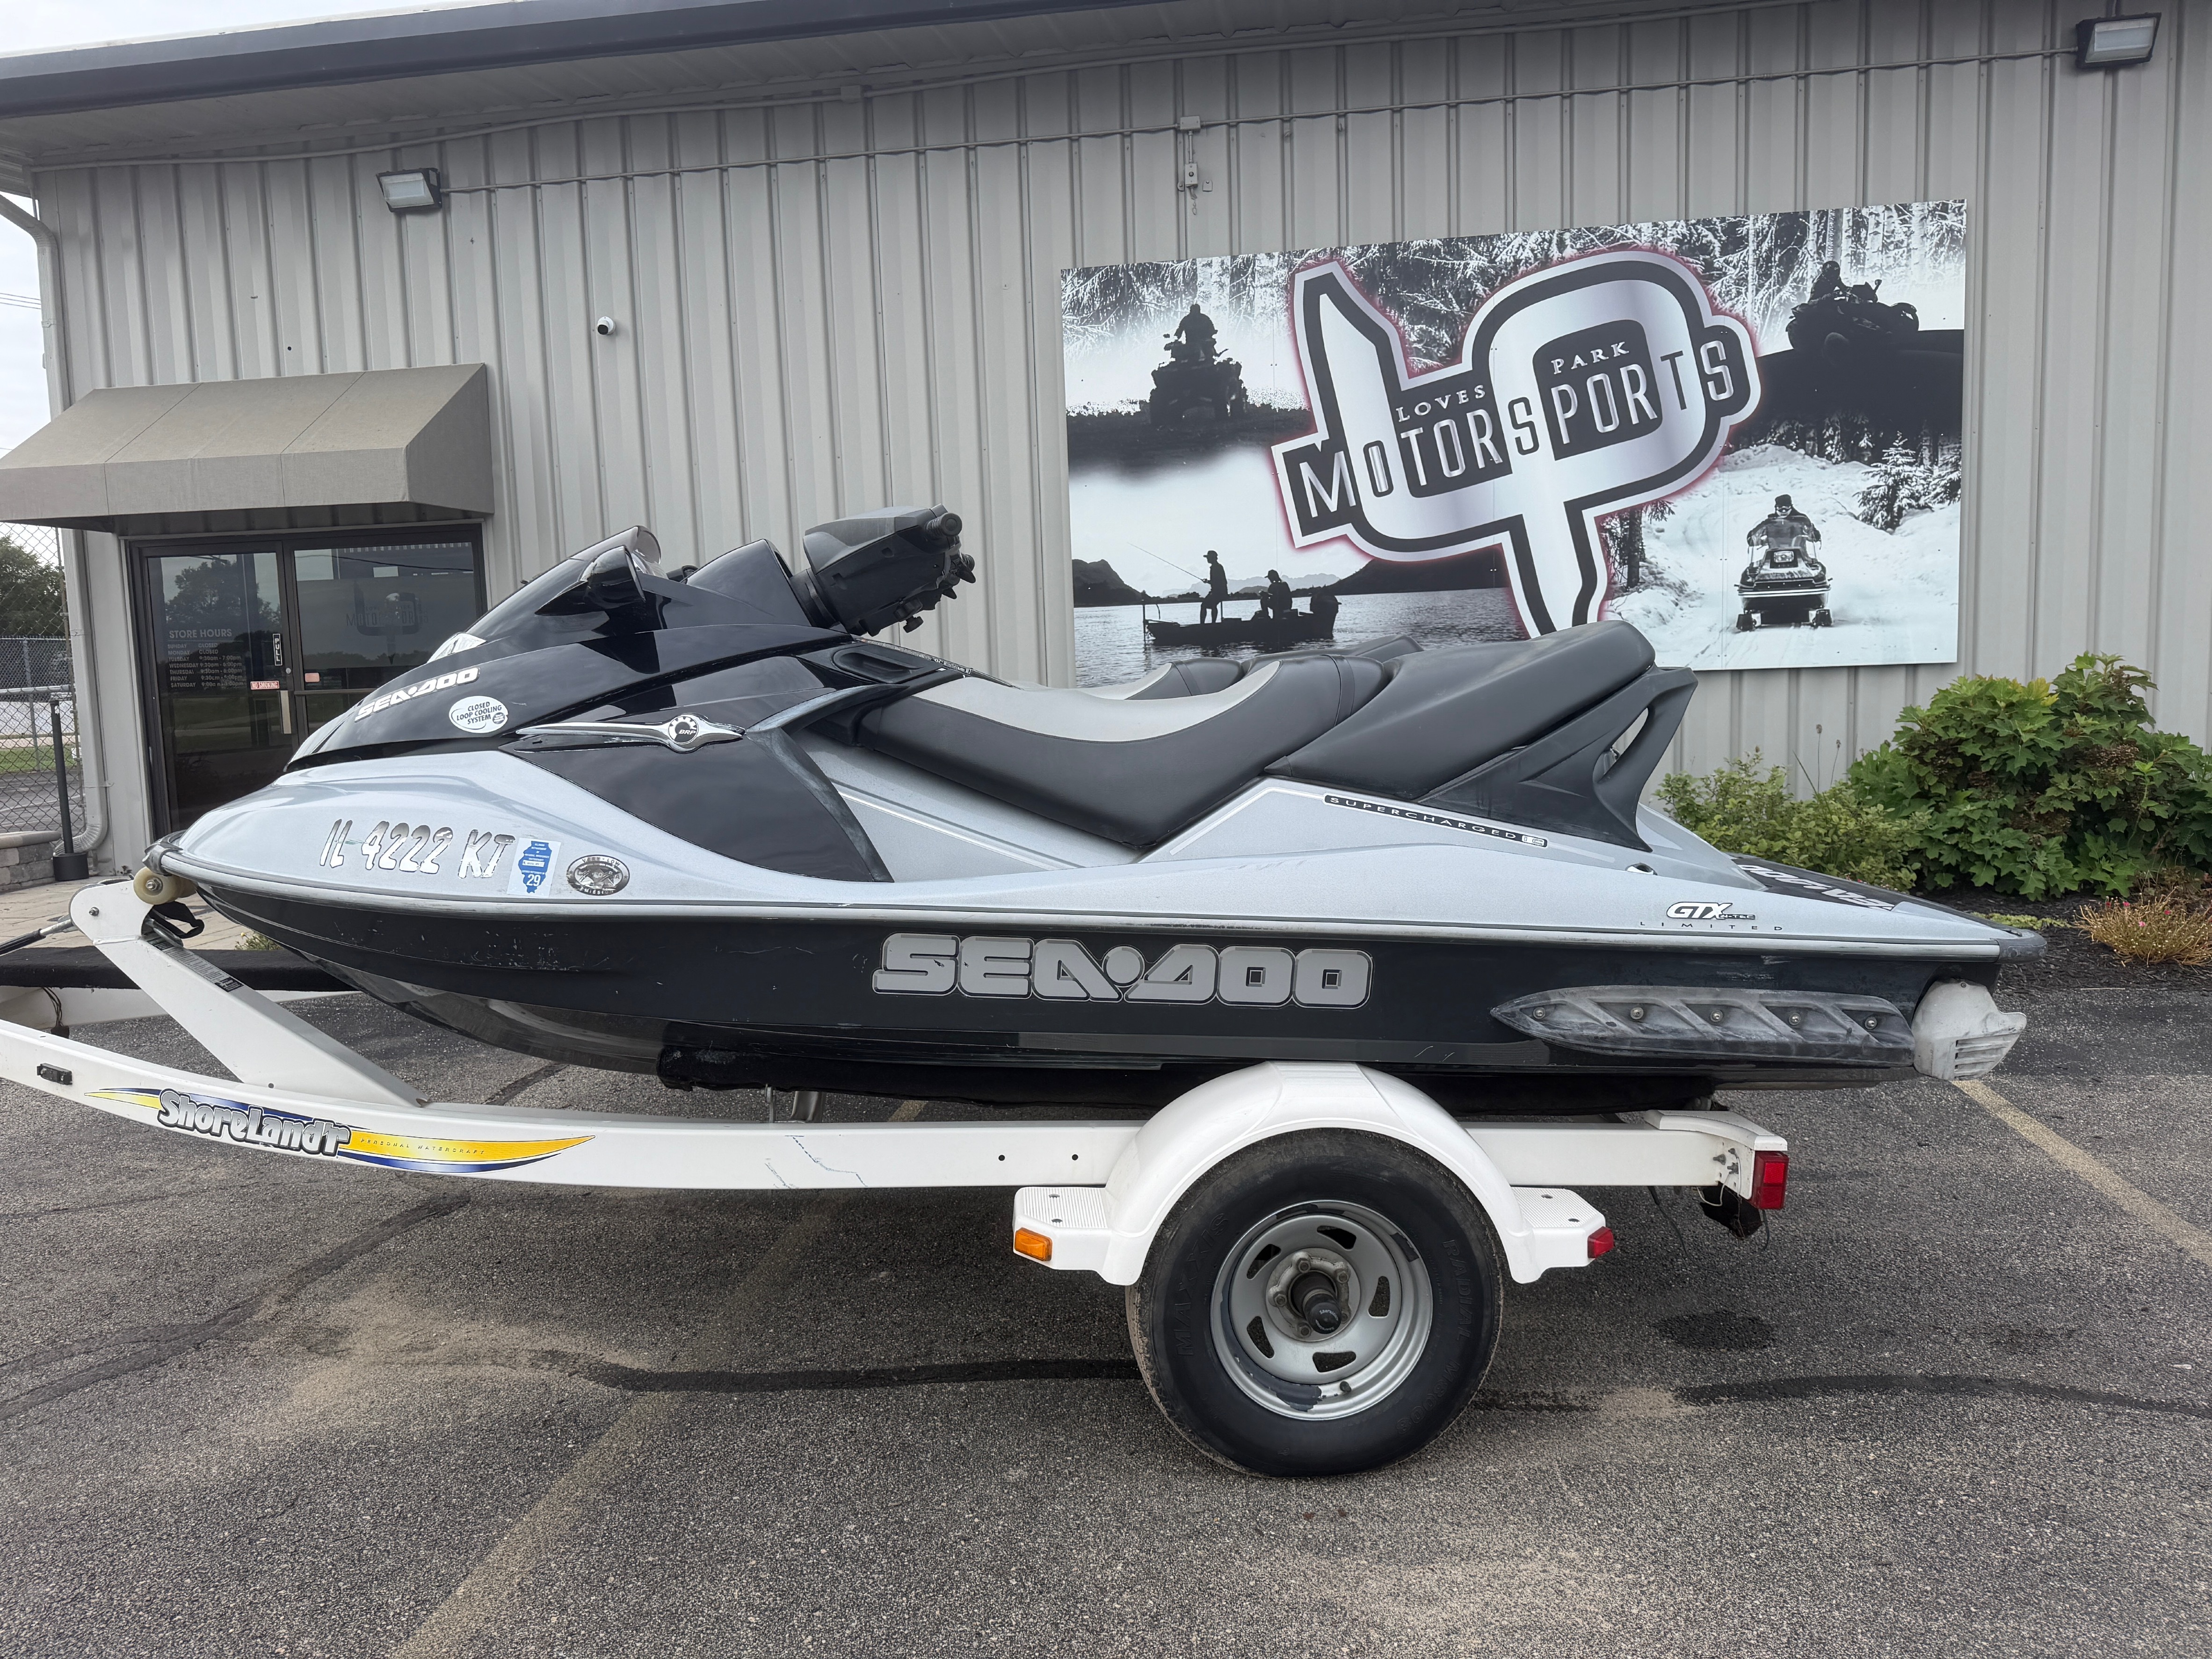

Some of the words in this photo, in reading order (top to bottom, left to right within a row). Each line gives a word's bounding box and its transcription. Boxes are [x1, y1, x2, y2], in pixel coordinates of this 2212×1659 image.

[1396, 385, 1485, 422] LOVES
[1551, 341, 1630, 375] PARK
[1298, 340, 1734, 518] MOTORSPORTS
[169, 630, 197, 638] STORE
[200, 629, 232, 637] HOURS
[457, 712, 473, 721] LOOP
[475, 705, 502, 716] COOLING
[468, 701, 490, 712] CLOSED
[468, 713, 492, 725] SYSTEM
[1330, 797, 1516, 839] SUPERCHARGED
[319, 819, 353, 868] IL
[361, 820, 454, 874] 4222
[457, 829, 516, 879] KT
[607, 858, 621, 866] LOW
[526, 874, 541, 887] 29
[1666, 901, 1733, 920] GTX
[1640, 921, 1783, 931] LIMITED
[361, 1138, 410, 1148] PERSONAL
[418, 1145, 485, 1154] WATERCRAFT
[1173, 1212, 1229, 1356] MAXXIS
[1441, 1239, 1473, 1341] RADIAL
